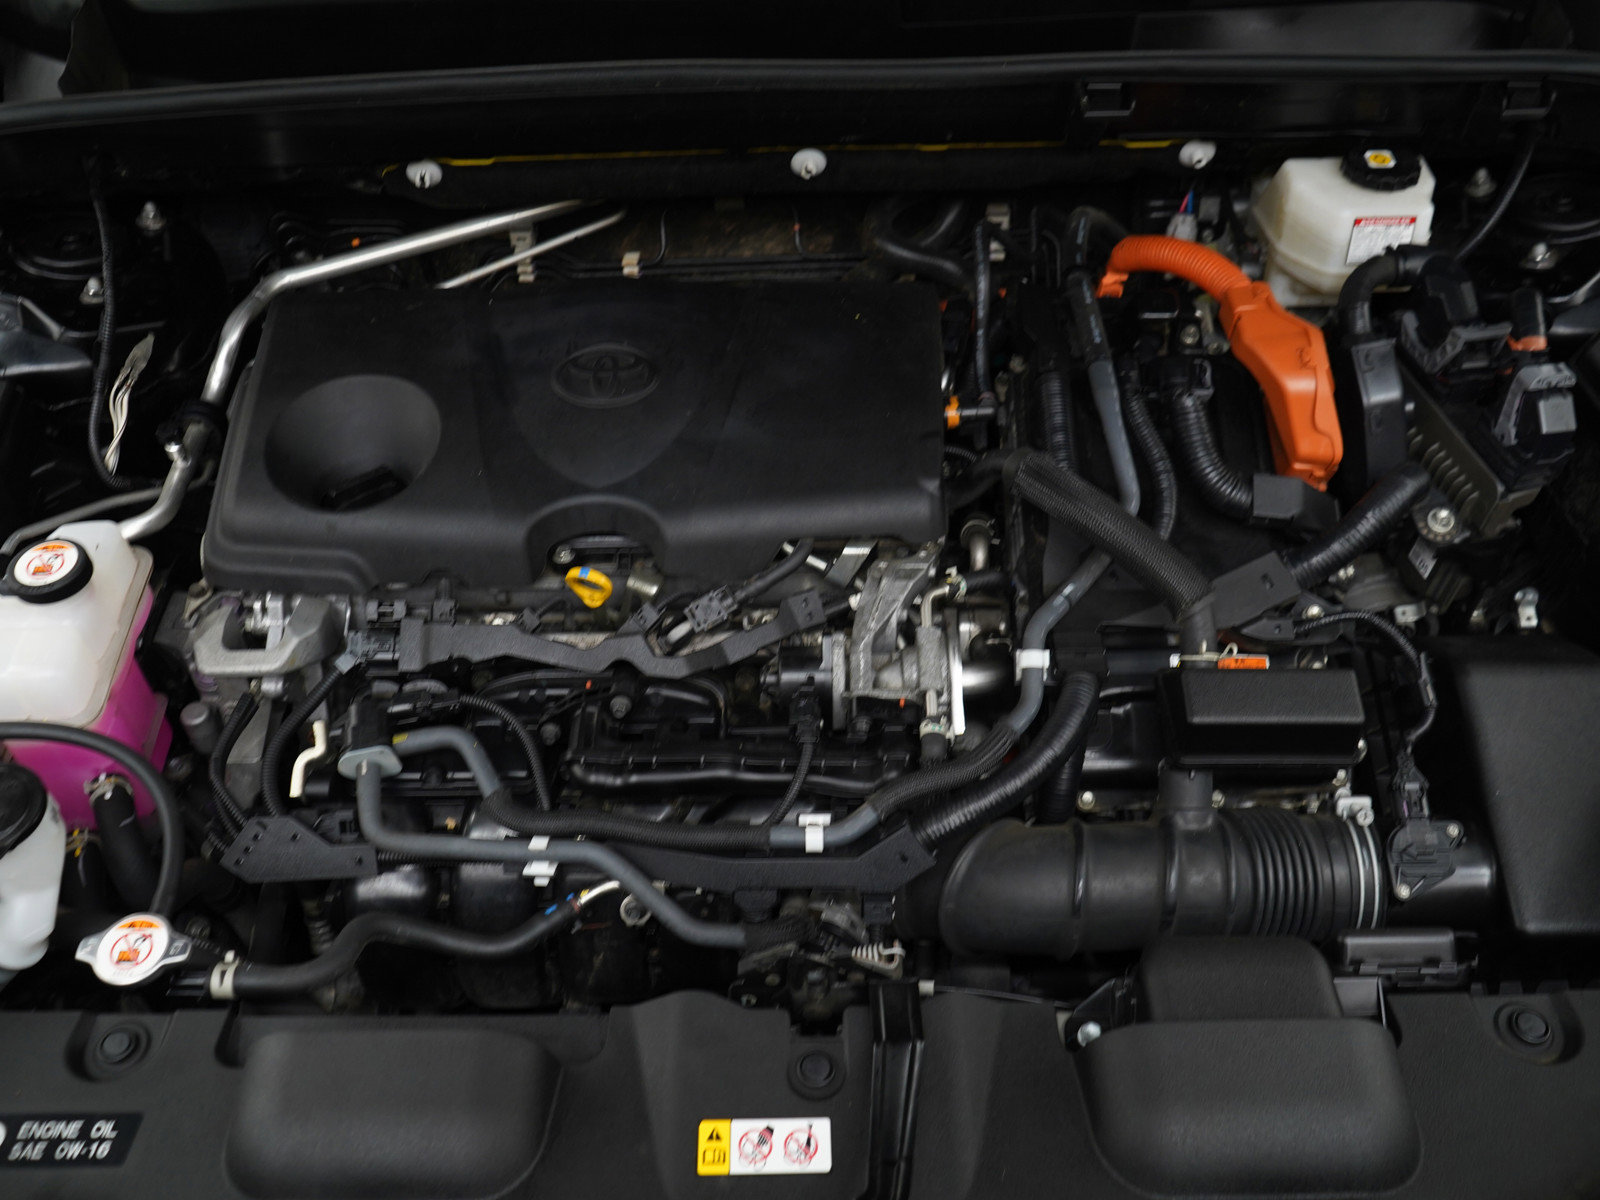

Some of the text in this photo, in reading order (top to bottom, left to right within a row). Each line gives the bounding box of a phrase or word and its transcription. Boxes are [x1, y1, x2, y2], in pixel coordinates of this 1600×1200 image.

[16, 1119, 119, 1140] ENGINE OIL
[7, 1140, 114, 1161] SAE 0W-16
